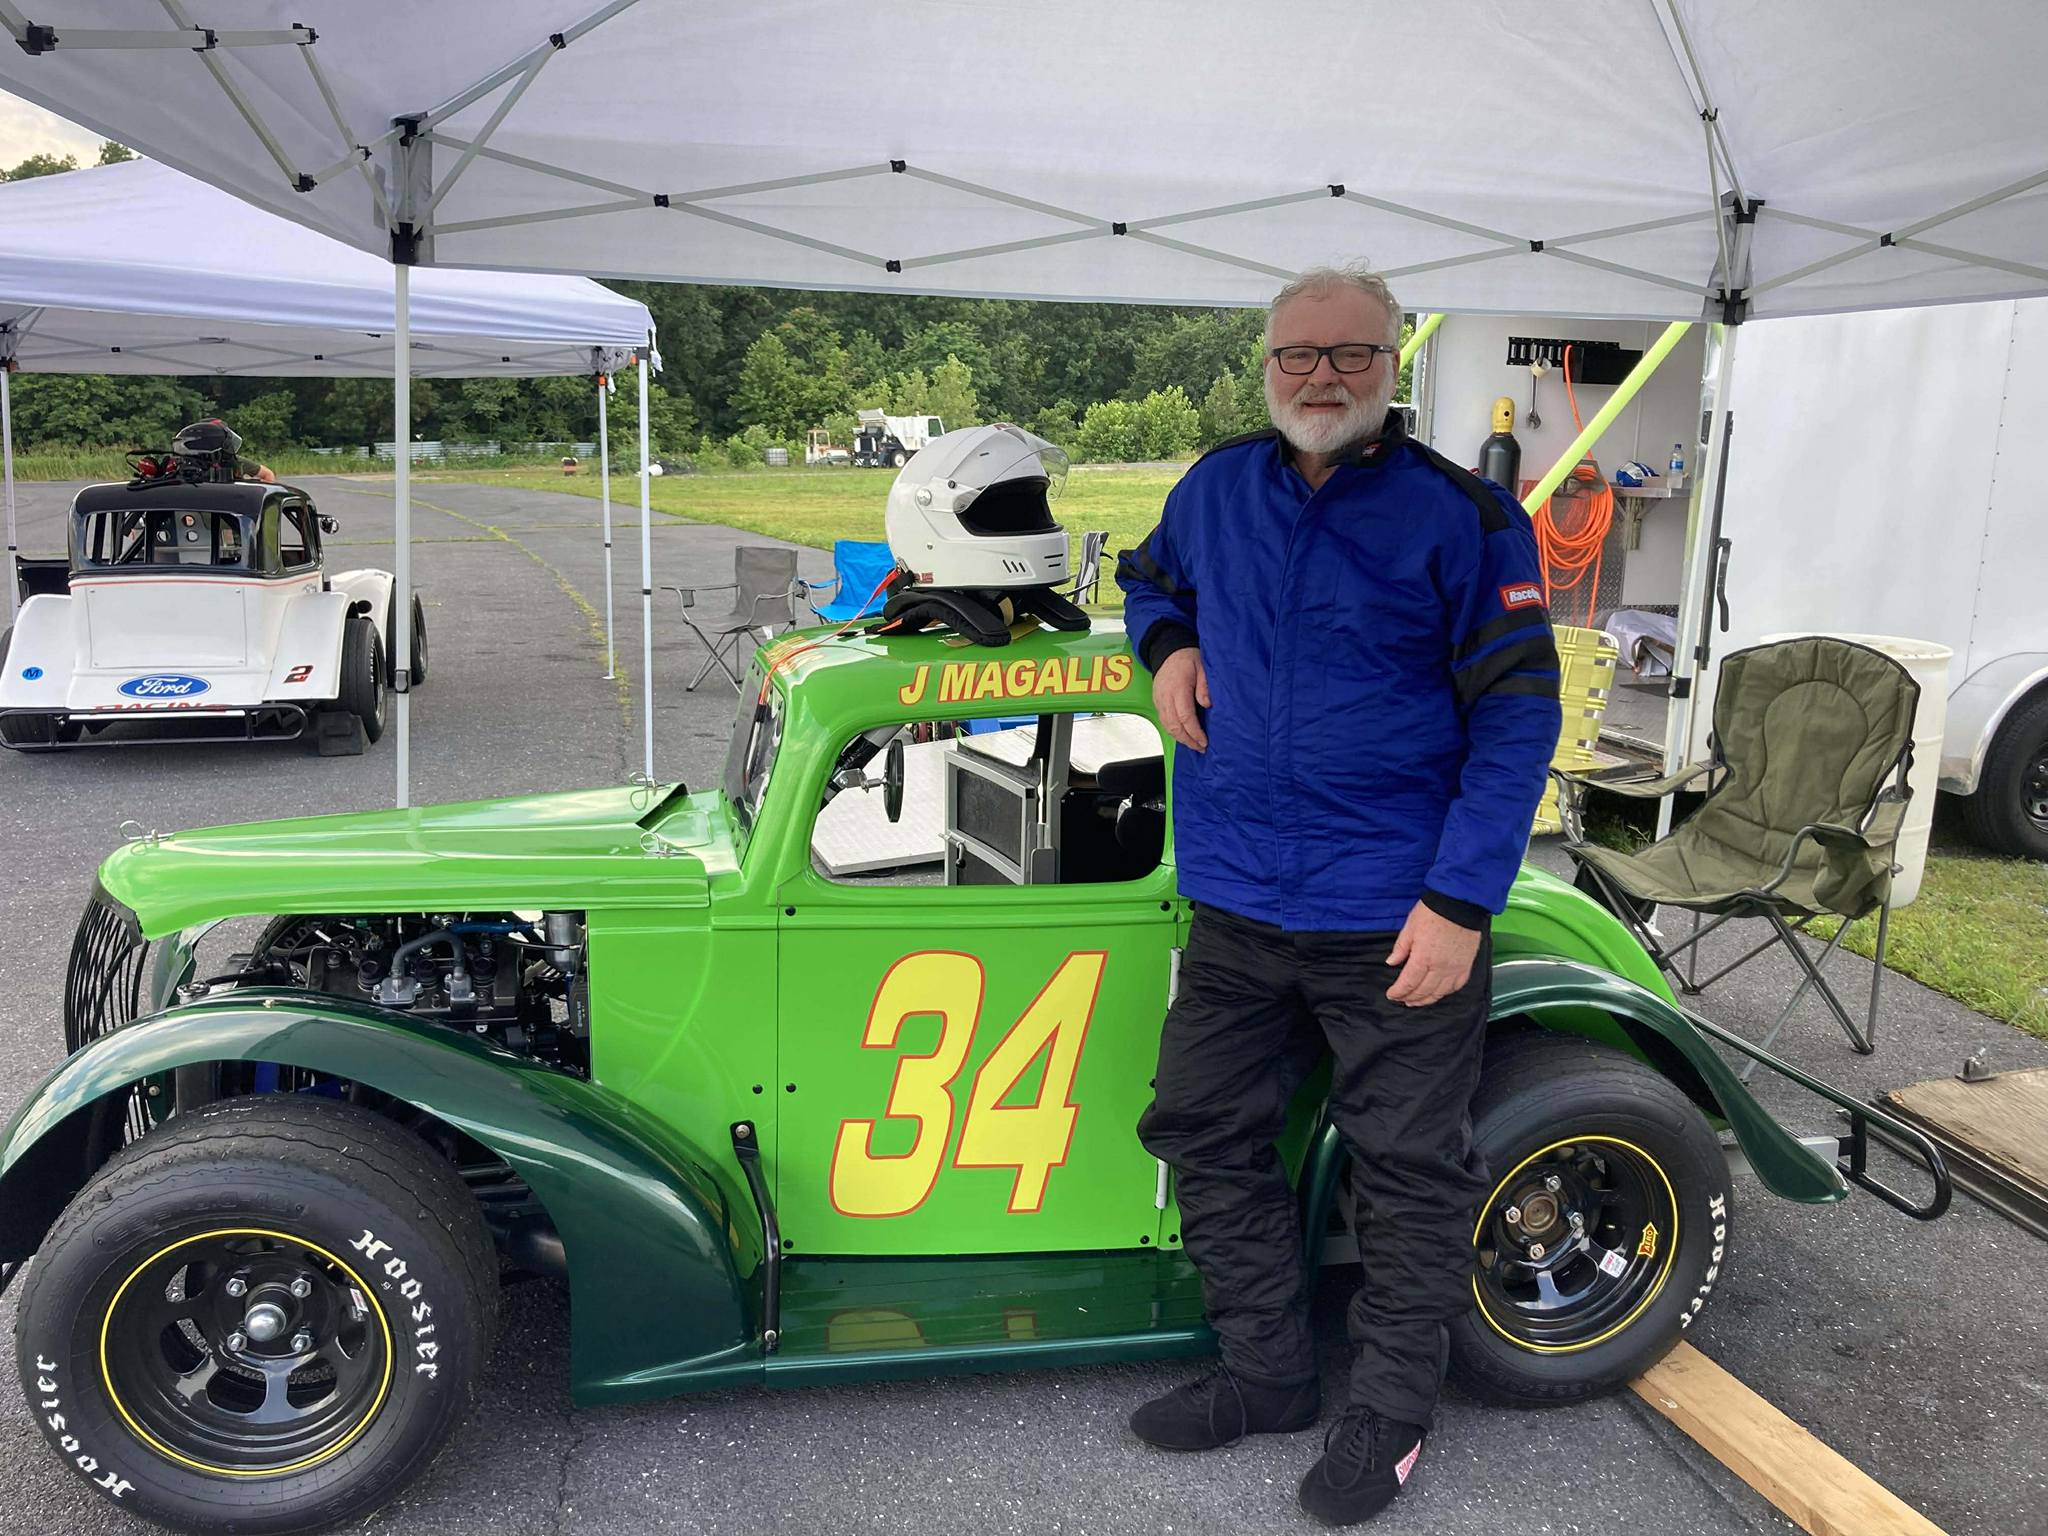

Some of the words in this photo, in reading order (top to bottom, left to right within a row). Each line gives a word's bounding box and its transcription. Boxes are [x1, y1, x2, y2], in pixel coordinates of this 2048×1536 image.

[135, 677, 193, 695] Ford
[283, 664, 315, 684] 2
[899, 664, 930, 705] J
[937, 654, 1134, 703] MAGALIS
[828, 949, 1109, 1219] 34
[348, 1229, 440, 1380] Hoosier
[1680, 1192, 1727, 1329] Hoosier
[36, 1354, 137, 1498] Hoosier
